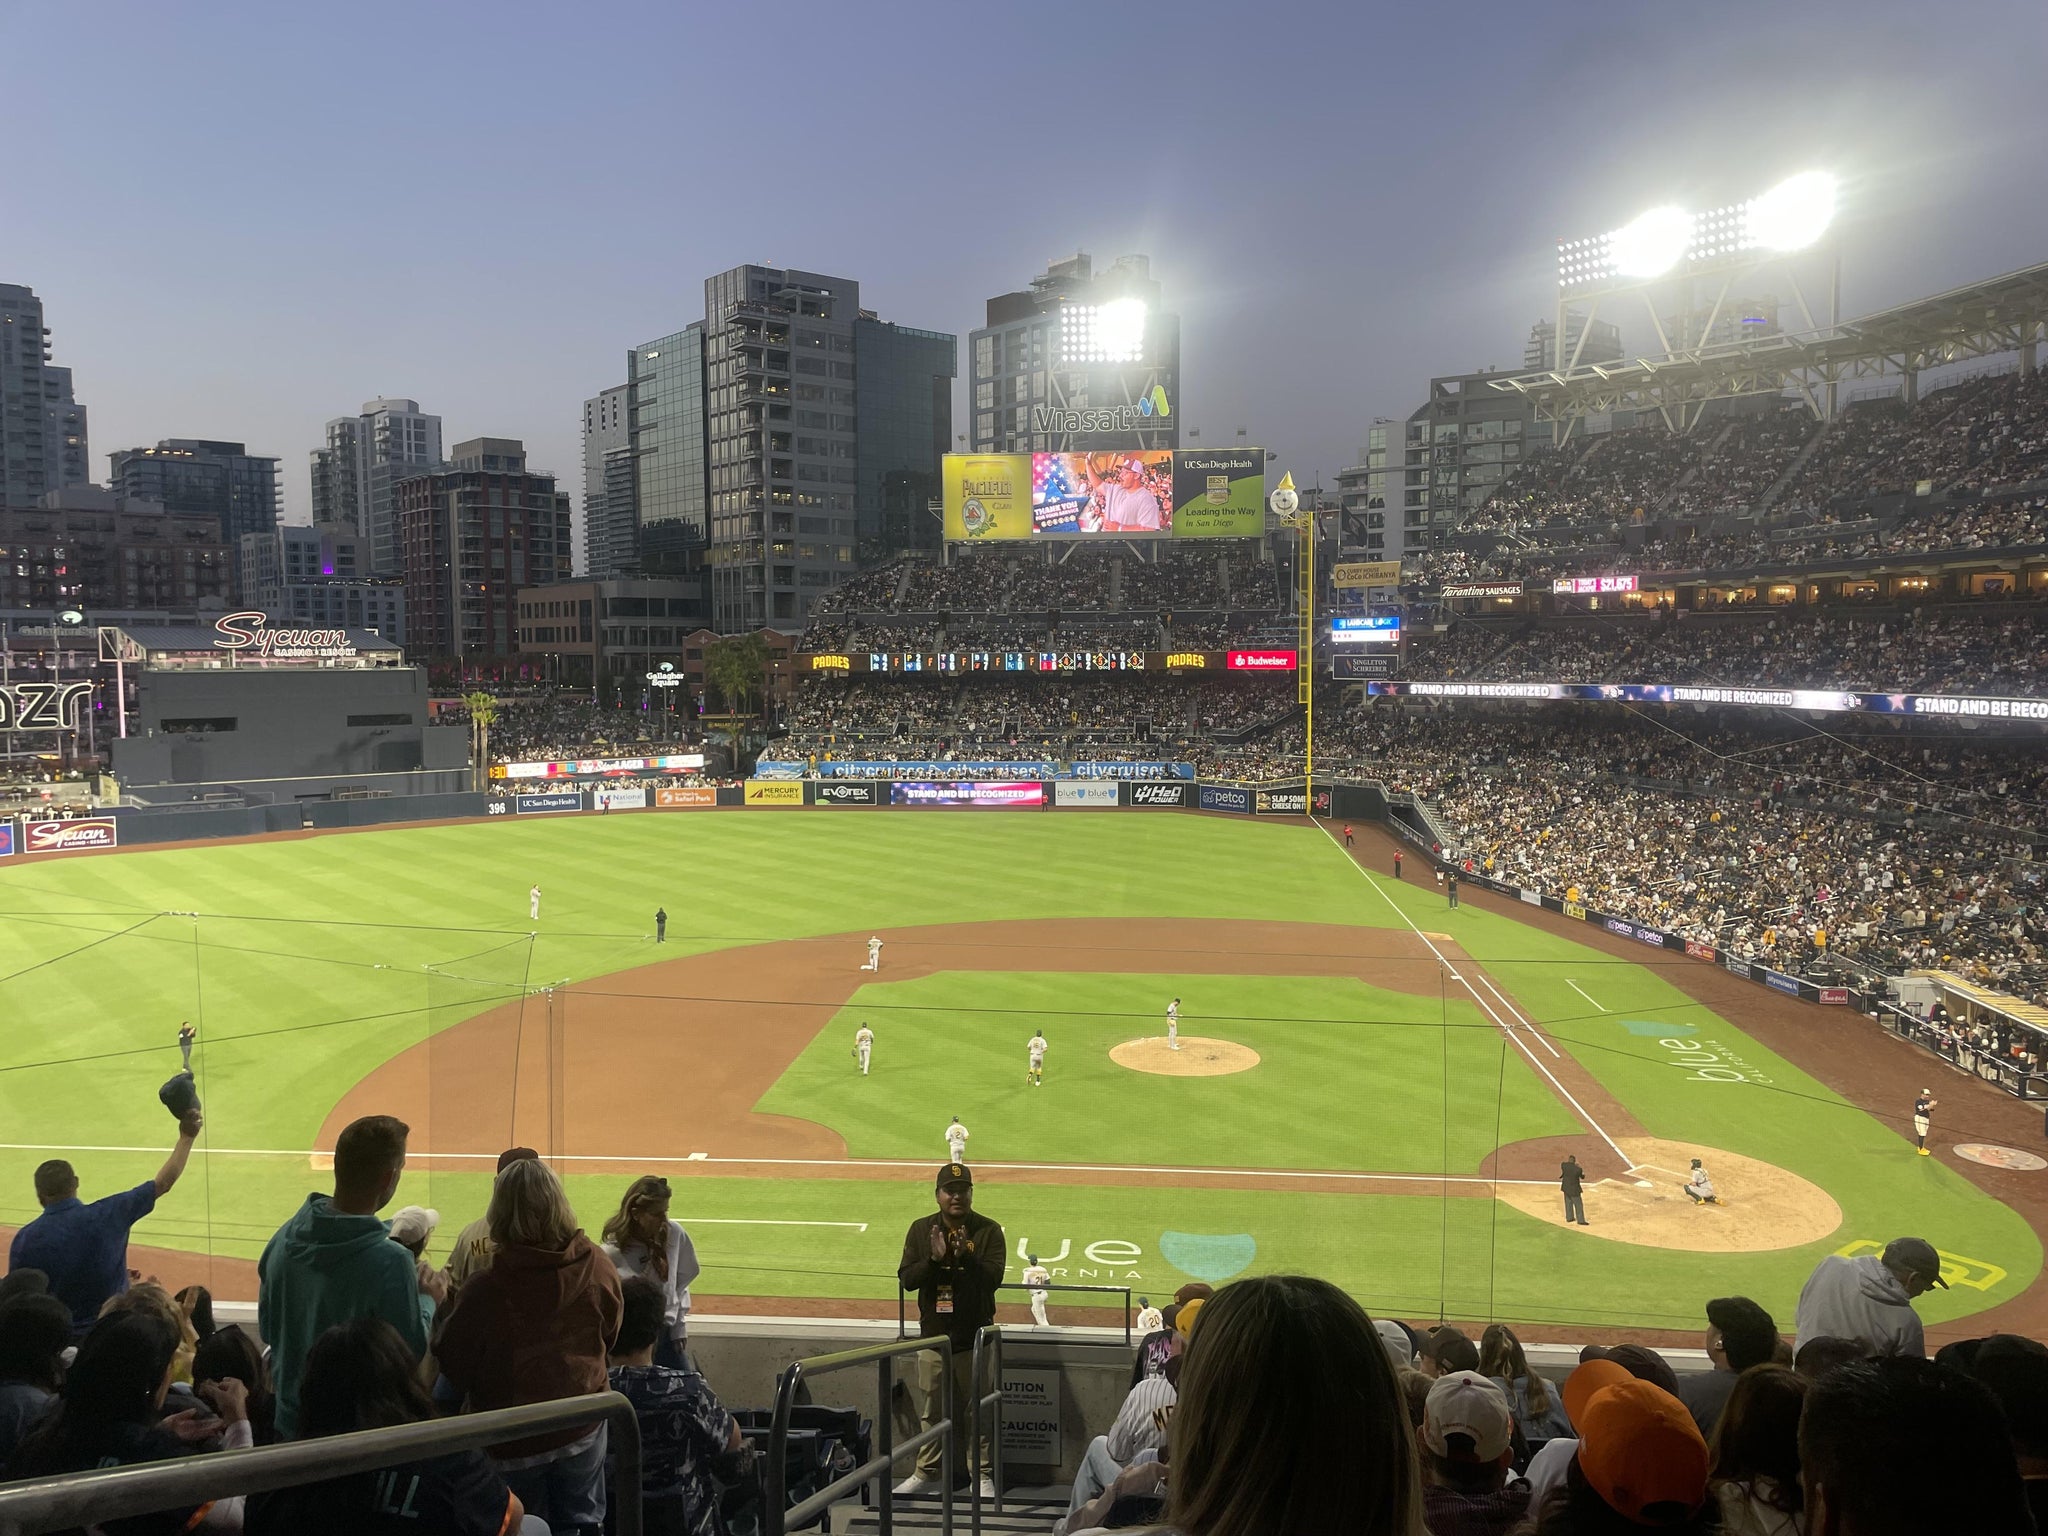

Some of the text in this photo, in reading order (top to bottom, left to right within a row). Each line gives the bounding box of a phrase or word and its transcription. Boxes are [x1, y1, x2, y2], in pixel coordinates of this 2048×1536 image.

[1035, 405, 1131, 433] Viasat
[1184, 460, 1253, 470] UC San Diego Health
[1034, 500, 1078, 514] THANK YOU
[1186, 508, 1220, 516] Leading
[1238, 507, 1256, 516] Way
[1196, 519, 1211, 527] San
[1213, 519, 1234, 528] Diego
[1442, 585, 1521, 597] Tarantino SAUSAGES
[213, 611, 351, 657] Sycuan
[812, 654, 850, 669] PADRES
[1166, 653, 1205, 668] PADRES
[1247, 655, 1288, 666] Budweiser
[646, 672, 685, 680] Gallagher
[652, 679, 679, 688] Square
[1410, 684, 1549, 697] STAND AND BE RECOGNIZED
[1673, 688, 1793, 706] STAND AND BE RECOGNIZED
[1914, 697, 1960, 713] STAND
[1959, 699, 1990, 715] AND
[1990, 701, 2009, 717] BE
[613, 793, 643, 801] National
[822, 786, 869, 798] EVOTEK
[907, 789, 1024, 798] STAND AND BE RECOGNIZED
[1057, 788, 1108, 797] blue blue
[543, 799, 559, 807] Diego
[1215, 792, 1246, 804] petco
[1271, 794, 1289, 803] SLAP
[489, 803, 506, 814] 396
[1271, 802, 1292, 810] CHEESE
[1615, 920, 1664, 943] petco petco
[1658, 1038, 1750, 1082] blue
[1148, 1314, 1160, 1328] 20
[1001, 1382, 1045, 1393] UTION
